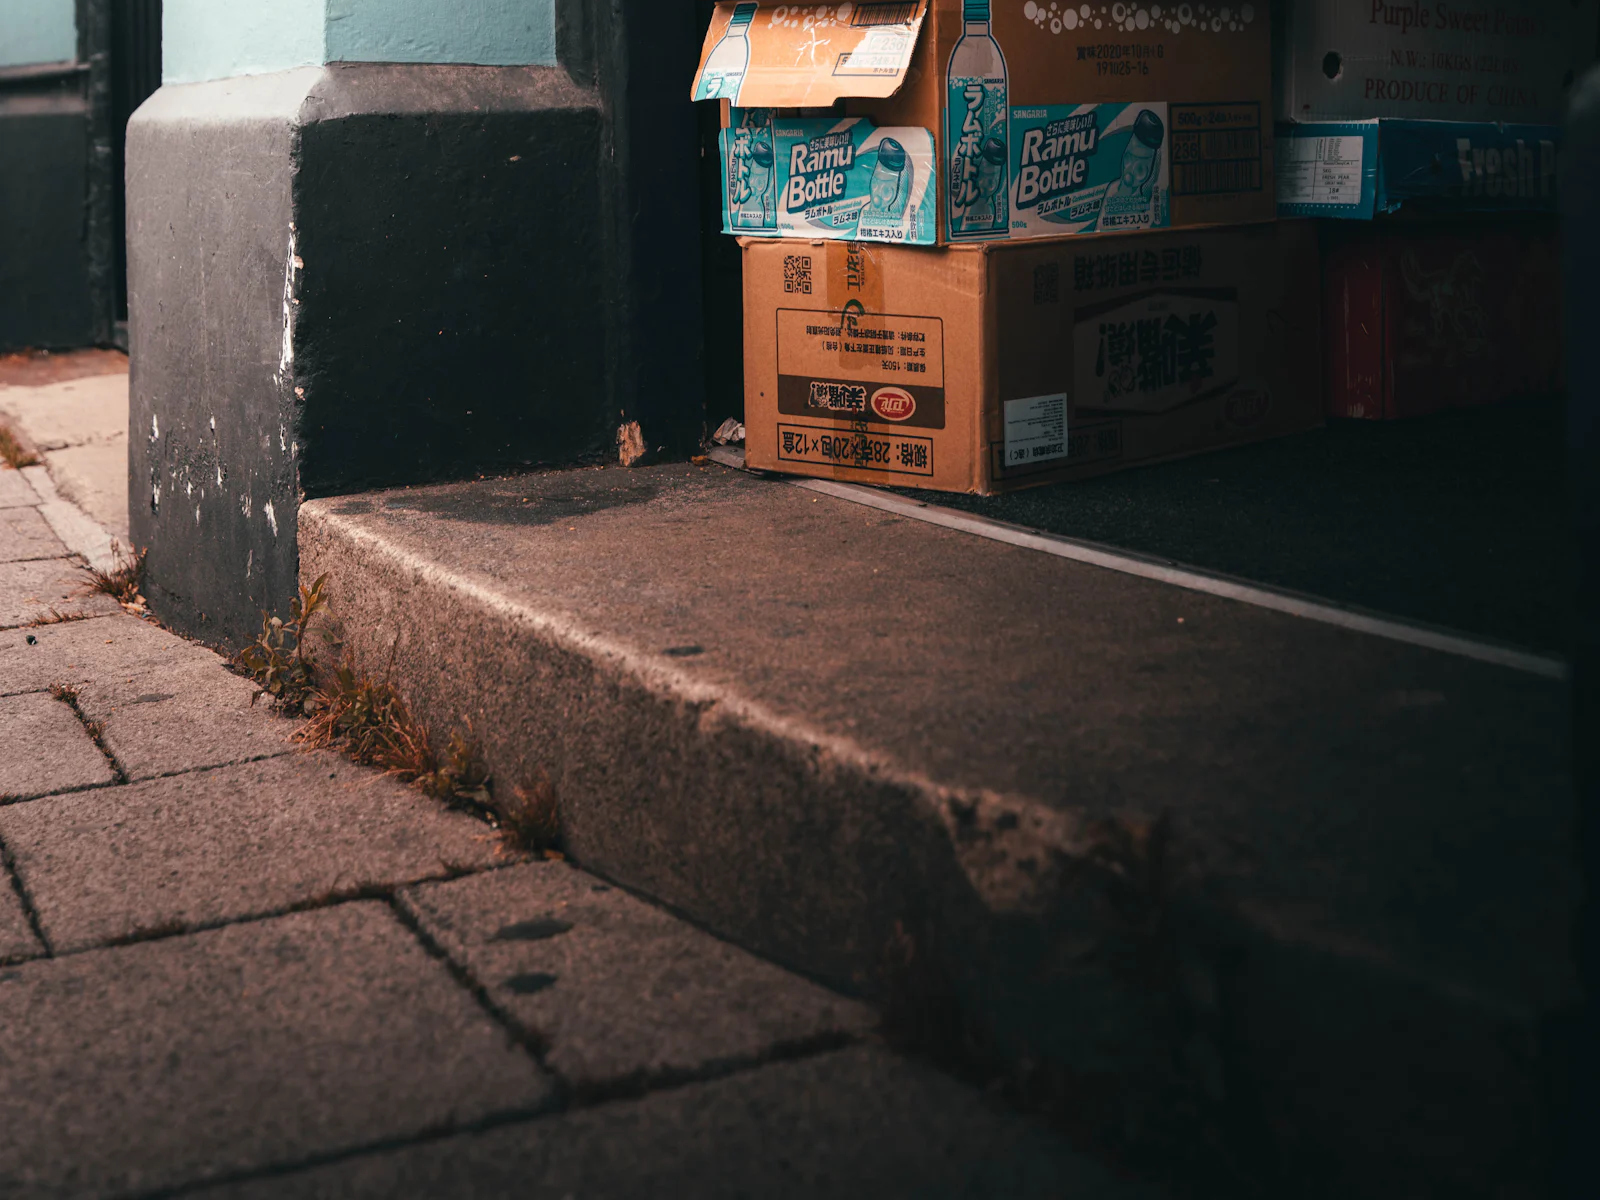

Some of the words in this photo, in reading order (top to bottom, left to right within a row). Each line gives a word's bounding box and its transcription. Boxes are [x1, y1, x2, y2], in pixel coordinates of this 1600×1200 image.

[1435, 3, 1488, 33] Sweet
[1364, 78, 1449, 104] PRODUCE
[1456, 84, 1481, 106] OF
[1486, 85, 1540, 108] CHINA
[1013, 109, 1048, 120] SANGARIA
[775, 129, 805, 137] SANGARIA
[954, 85, 984, 207] ラムボトル
[1021, 126, 1096, 166] Ramu
[789, 143, 853, 176] Ramu
[1456, 137, 1534, 199] Fresh
[788, 169, 845, 210] Bottle
[1018, 158, 1087, 204] Bottle
[804, 206, 832, 220] ラムボトル
[1037, 196, 1070, 215] ラムボトル
[860, 228, 904, 241] 柑橘エキス入り
[1012, 221, 1028, 229] 500g
[878, 396, 905, 413] 卫龙
